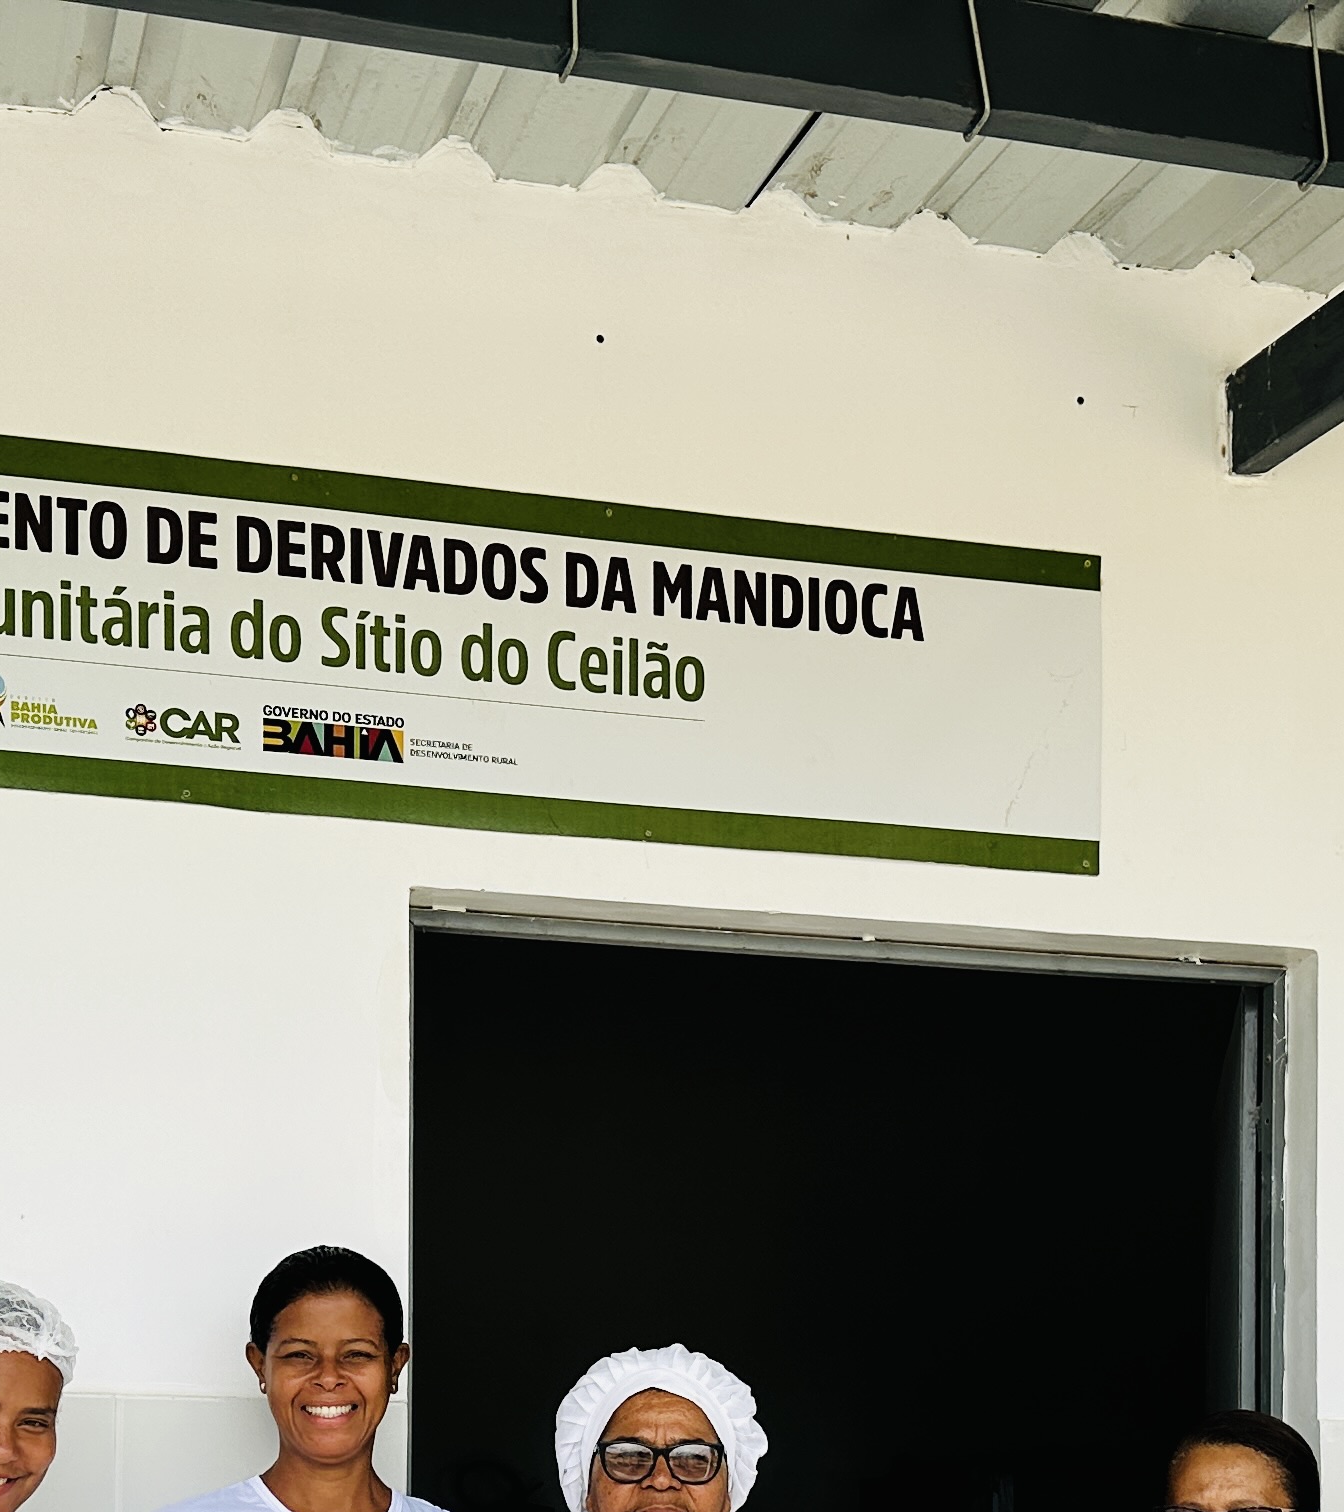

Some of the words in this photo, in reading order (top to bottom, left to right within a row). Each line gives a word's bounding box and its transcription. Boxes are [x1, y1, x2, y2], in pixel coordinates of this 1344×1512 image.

[146, 504, 218, 570] DE
[236, 515, 549, 605] DERIVADOS
[565, 551, 637, 615] DA
[653, 560, 925, 642] MANDIOCA
[230, 600, 301, 664] do
[321, 606, 443, 678] Sítio
[460, 622, 529, 686] do
[546, 629, 706, 702] Ceilão
[10, 700, 58, 715] BAHIA
[262, 704, 329, 722] GOVERNO
[332, 711, 352, 724] DO
[355, 713, 405, 729] ESTADO
[10, 711, 98, 730] PRODUTIVA
[159, 707, 241, 744] CAR
[262, 717, 404, 764] BAHIA
[409, 738, 460, 750] SECRETARIA
[461, 743, 473, 751] DE
[409, 749, 490, 763] DESENVOLVIMENTO
[491, 756, 519, 766] RURAL
